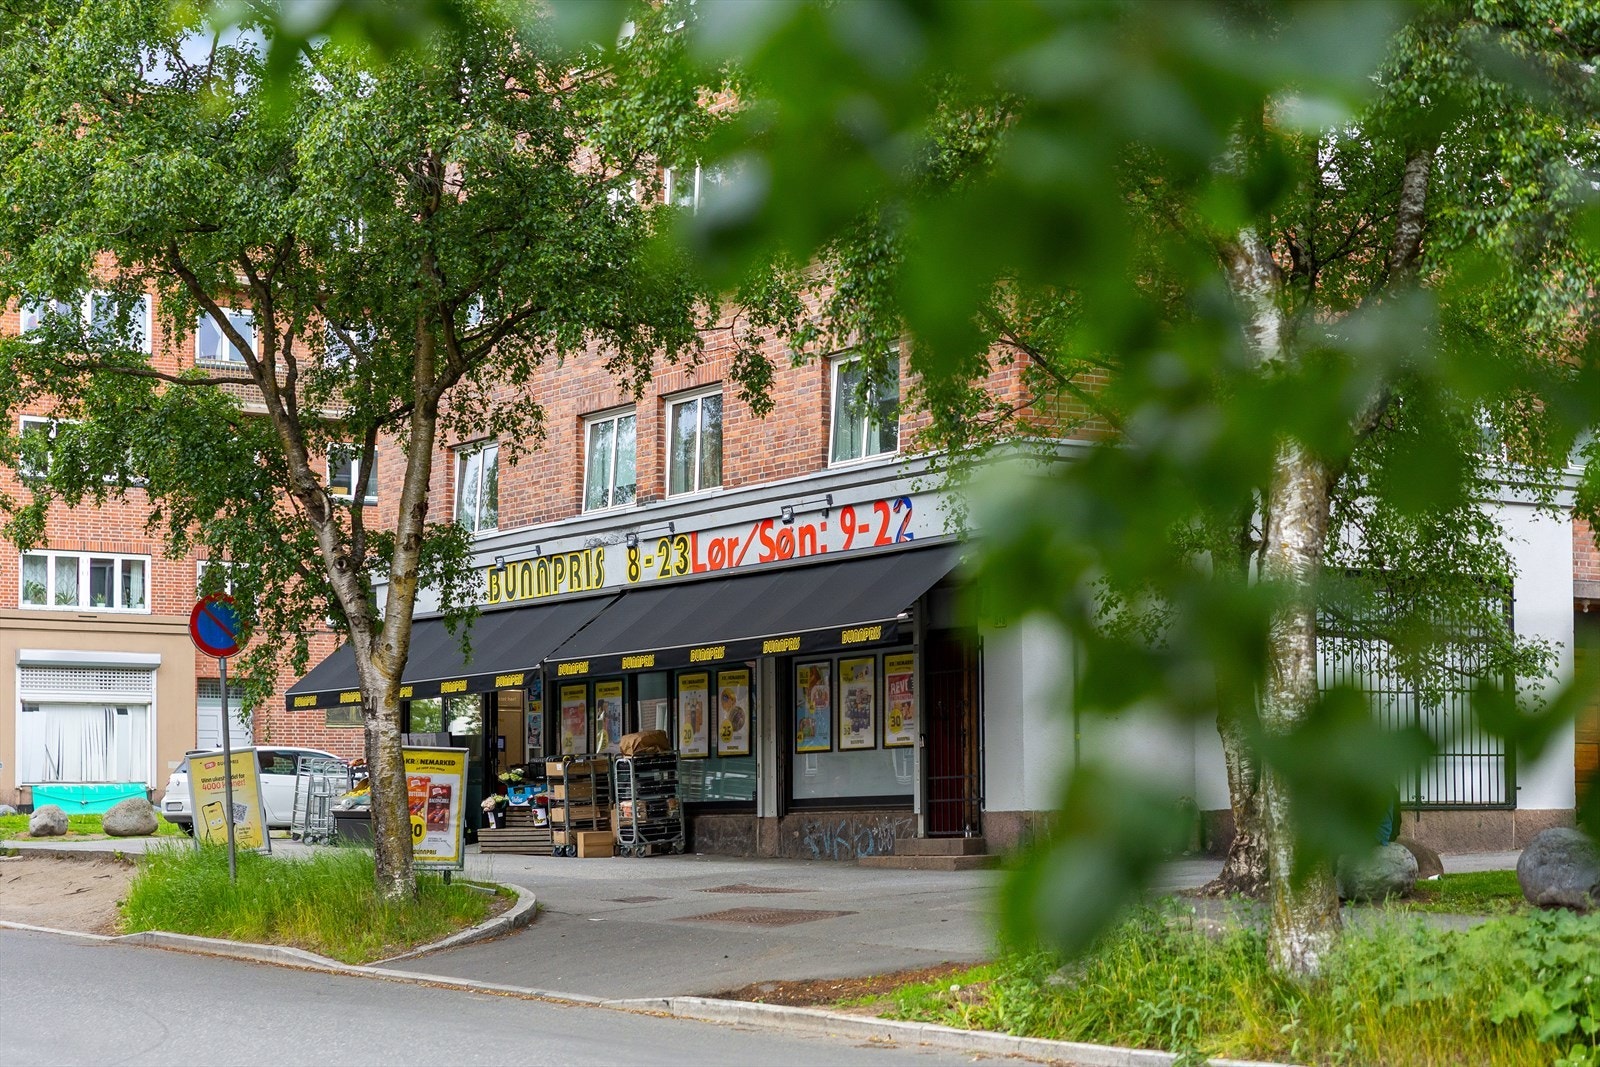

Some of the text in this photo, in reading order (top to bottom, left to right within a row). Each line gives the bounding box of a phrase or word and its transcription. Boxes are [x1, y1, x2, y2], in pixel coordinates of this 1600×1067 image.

[487, 547, 604, 604] BUNNPRIS
[691, 518, 828, 573] Lør/Søn:
[840, 496, 914, 550] 9-22
